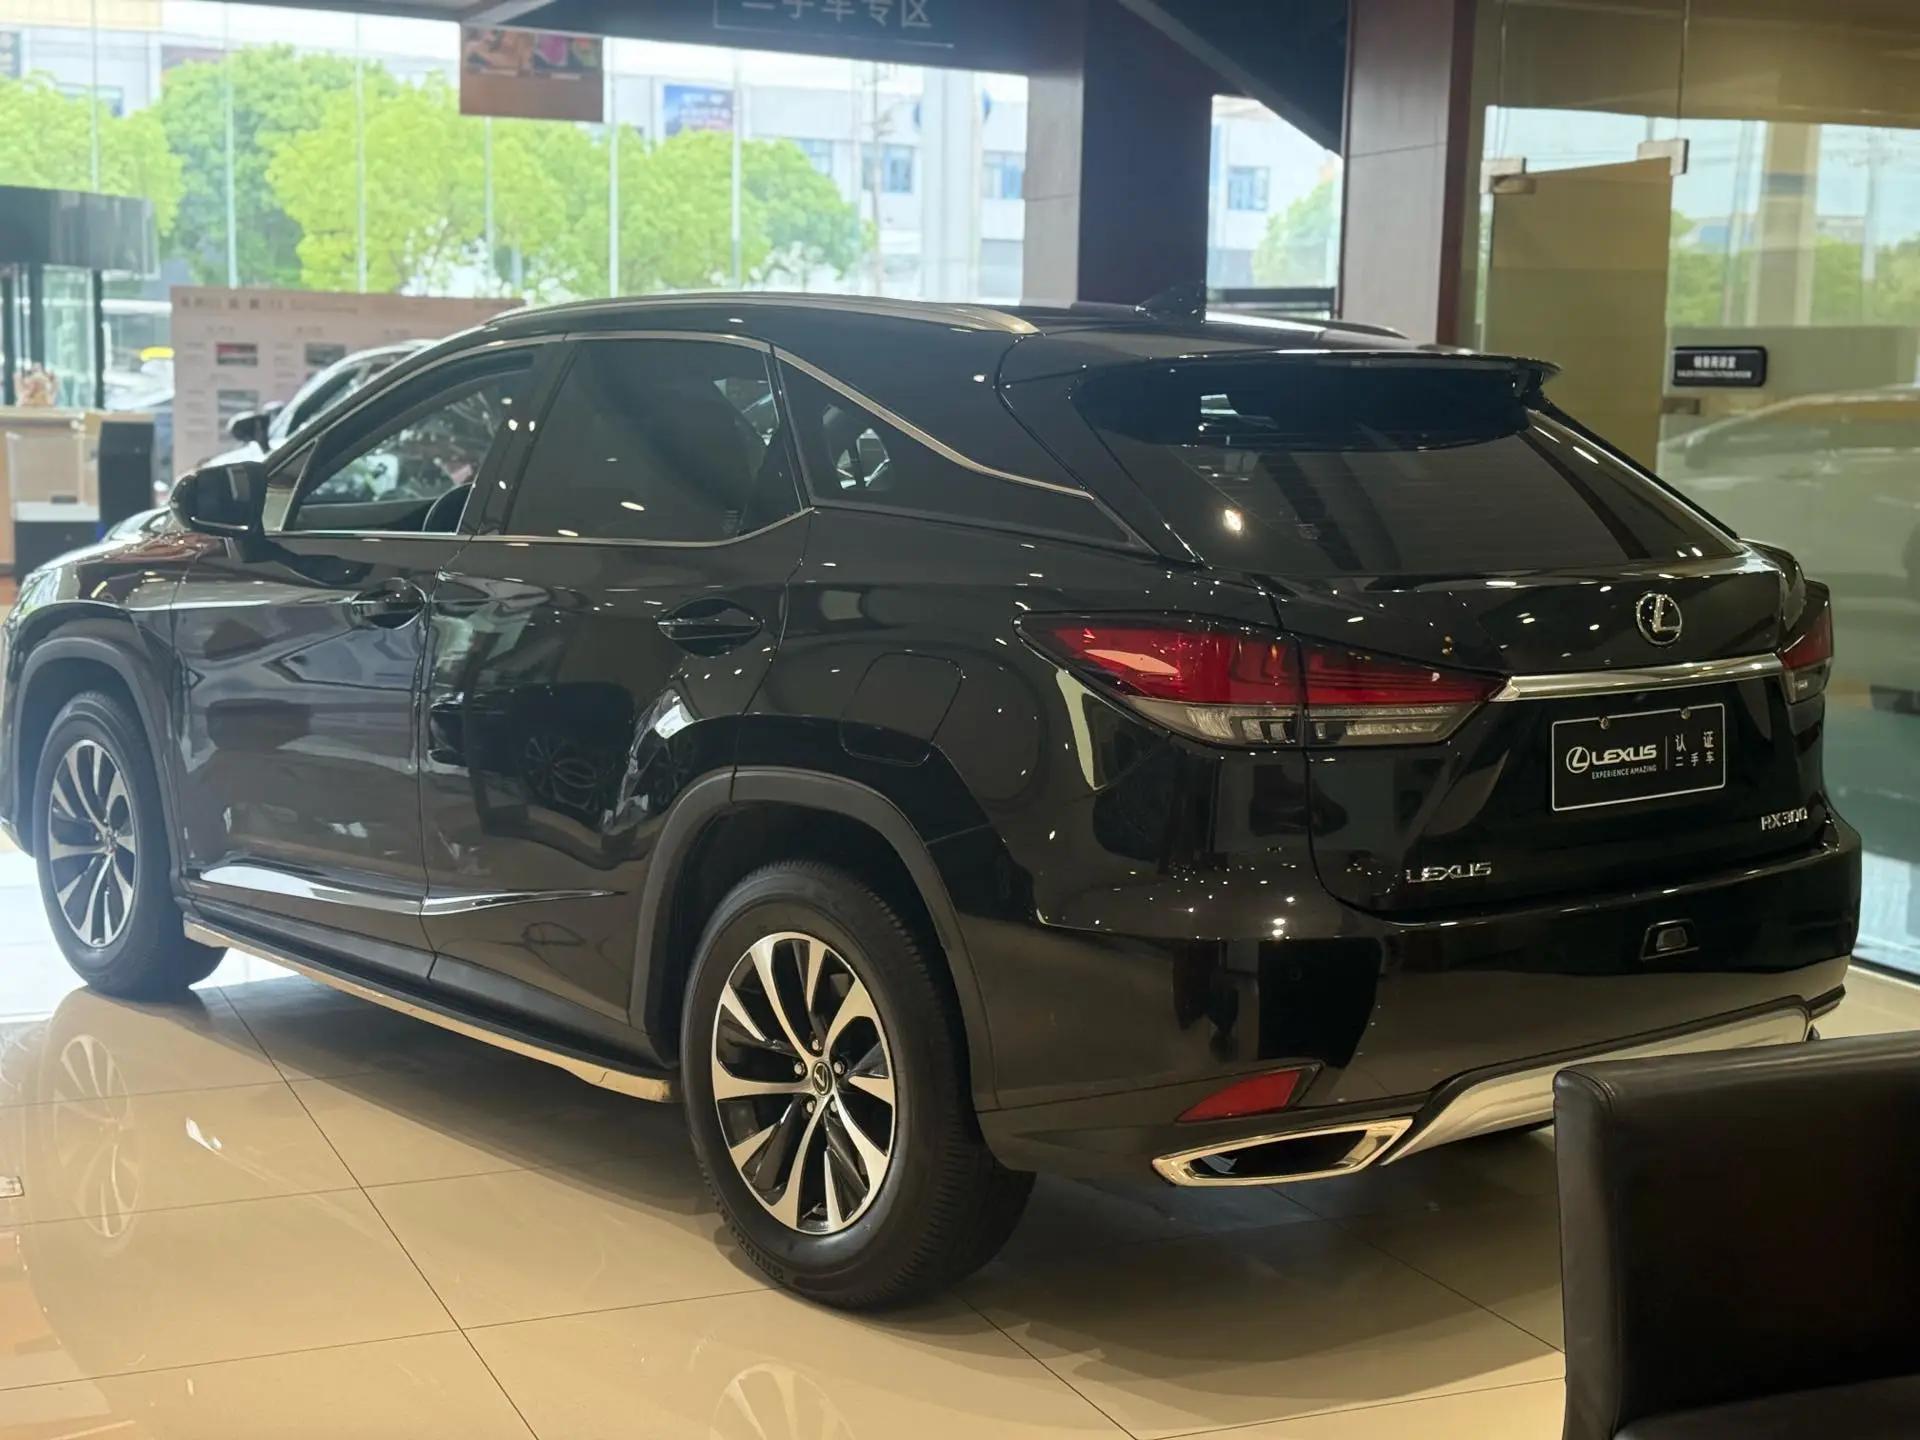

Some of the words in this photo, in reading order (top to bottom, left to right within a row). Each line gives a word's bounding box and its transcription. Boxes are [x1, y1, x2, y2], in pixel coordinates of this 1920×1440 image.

[1675, 731, 1714, 752] 认证
[1592, 745, 1657, 765] LEXUS
[1675, 751, 1715, 767] 二手车
[1592, 769, 1629, 780] EXPERIENCE
[1630, 765, 1657, 776] AMAZING
[1406, 862, 1491, 883] LEXUS
